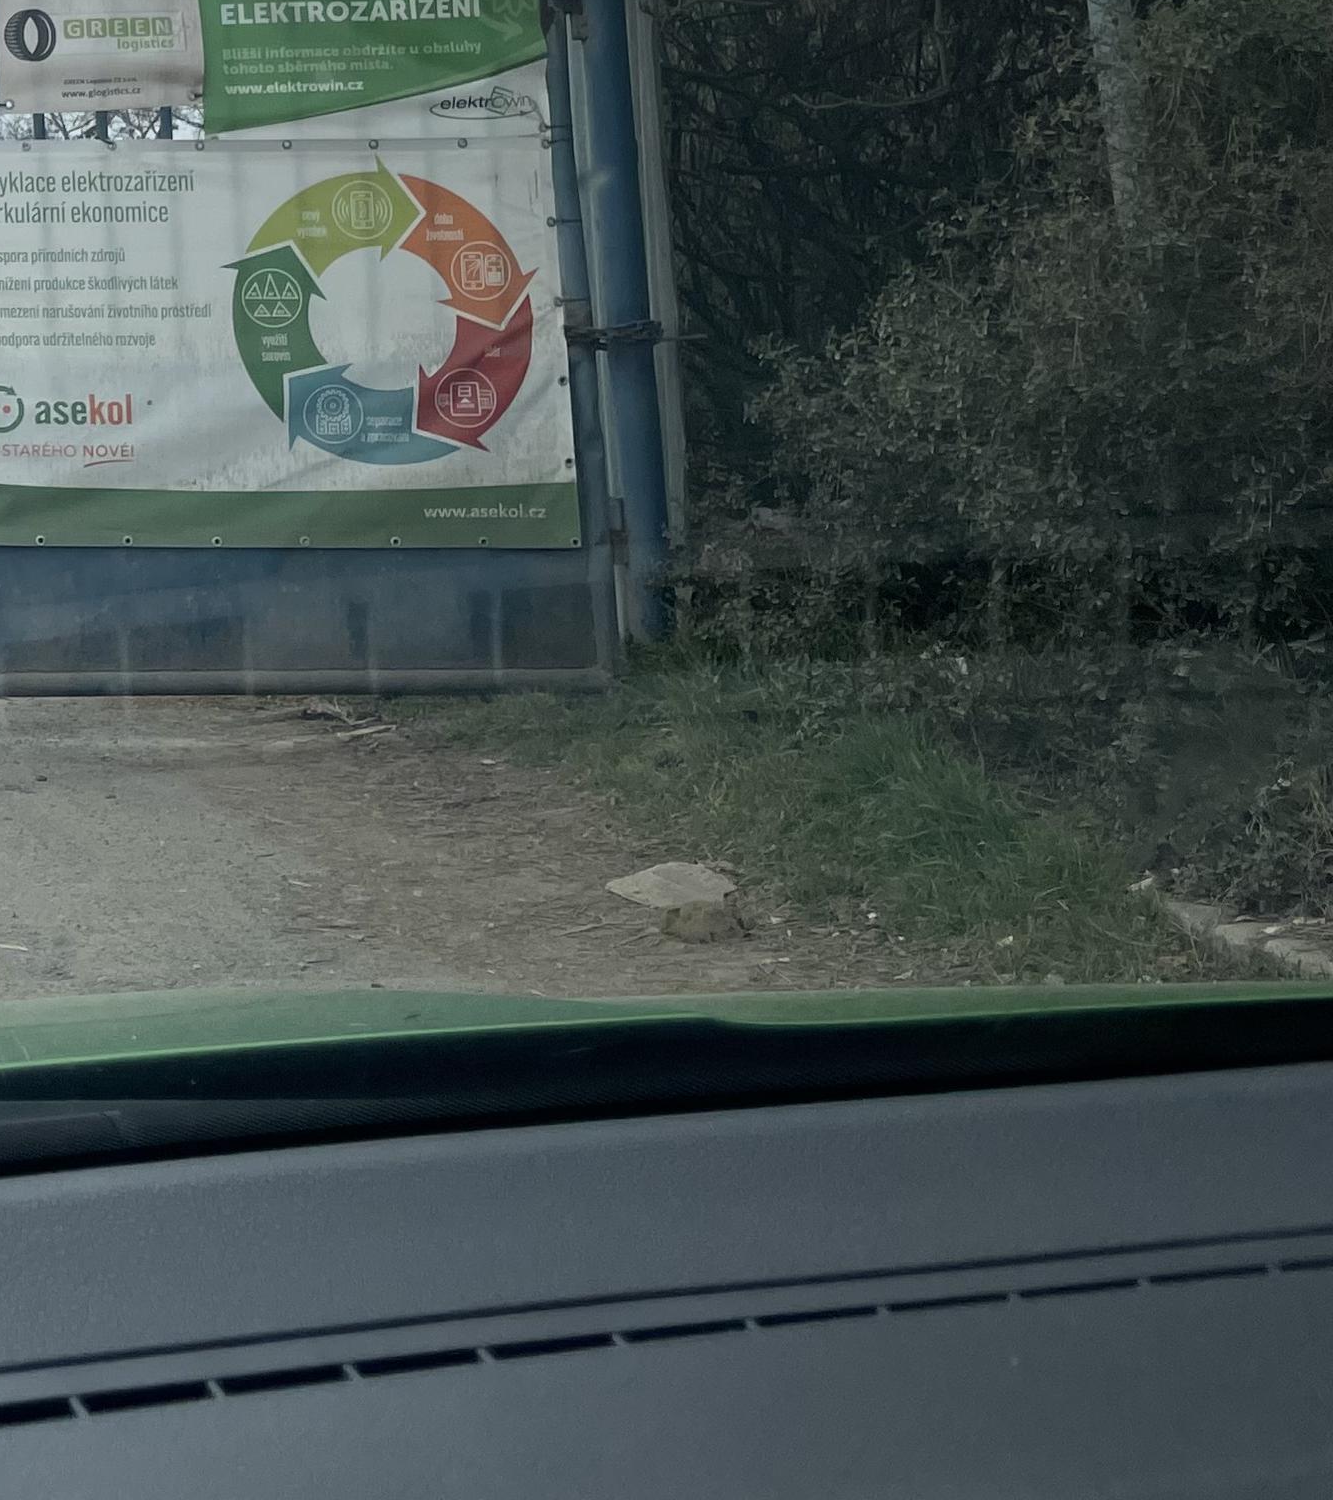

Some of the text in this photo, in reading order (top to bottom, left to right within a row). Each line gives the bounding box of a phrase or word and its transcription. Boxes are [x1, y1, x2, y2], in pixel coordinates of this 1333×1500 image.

[64, 17, 173, 39] GREEN
[117, 37, 174, 52] logistics
[222, 62, 274, 75] tohoto
[225, 79, 364, 95] www.elektrowin.cz
[61, 169, 194, 193] elektrozařízení
[70, 201, 169, 224] ekonomice
[31, 248, 88, 265] přírodních
[91, 247, 126, 265] zdrojů
[34, 276, 85, 293] produkce
[87, 276, 147, 293] škodlivých
[149, 275, 179, 290] látek
[42, 304, 105, 319] narušování
[107, 303, 158, 319] životního
[161, 303, 212, 320] prostředí
[42, 332, 113, 347] udržitelného
[115, 332, 156, 347] rozvoje
[34, 393, 133, 425] asekol
[2, 442, 77, 458] STARÉHO
[423, 503, 547, 519] www.asekol.cz
